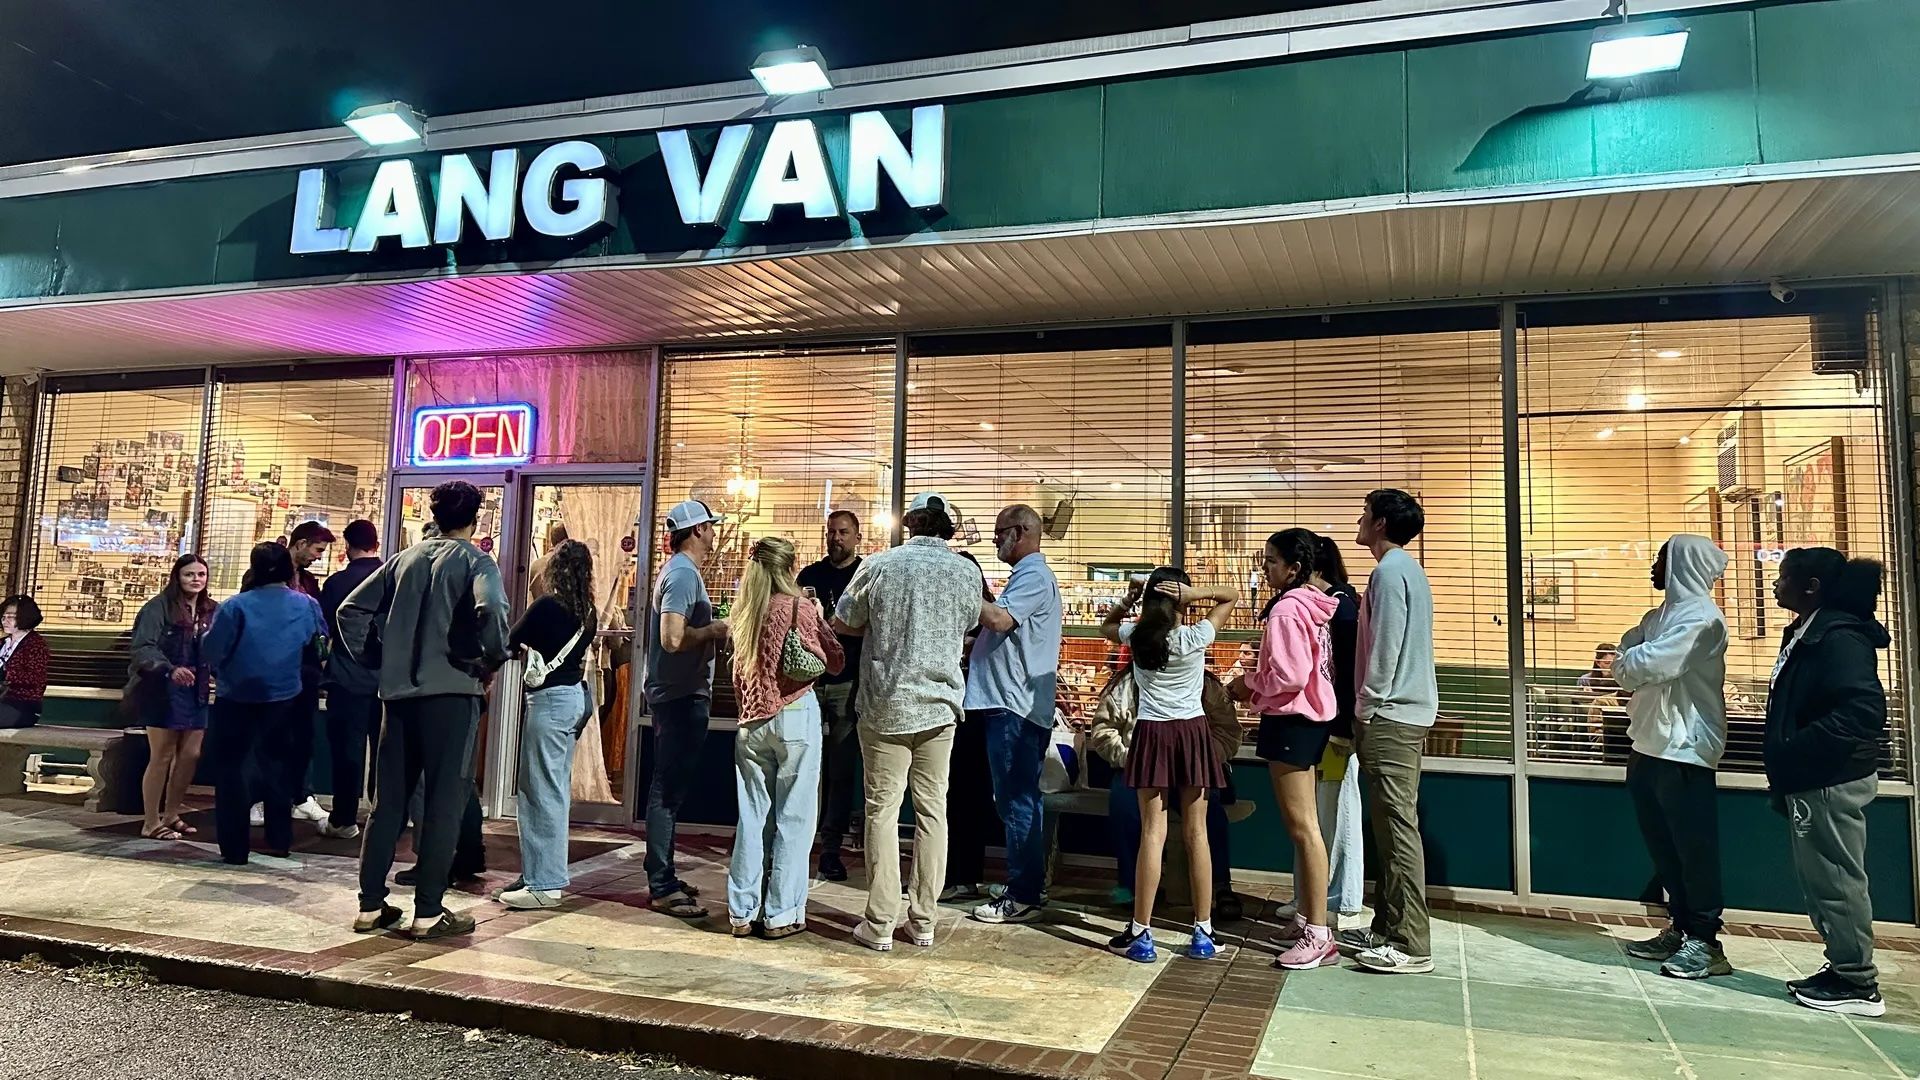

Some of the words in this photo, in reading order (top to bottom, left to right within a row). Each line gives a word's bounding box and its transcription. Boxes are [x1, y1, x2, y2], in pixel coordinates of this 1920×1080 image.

[290, 140, 608, 255] LANG
[656, 104, 946, 225] VAN
[420, 411, 525, 459] OPEN
